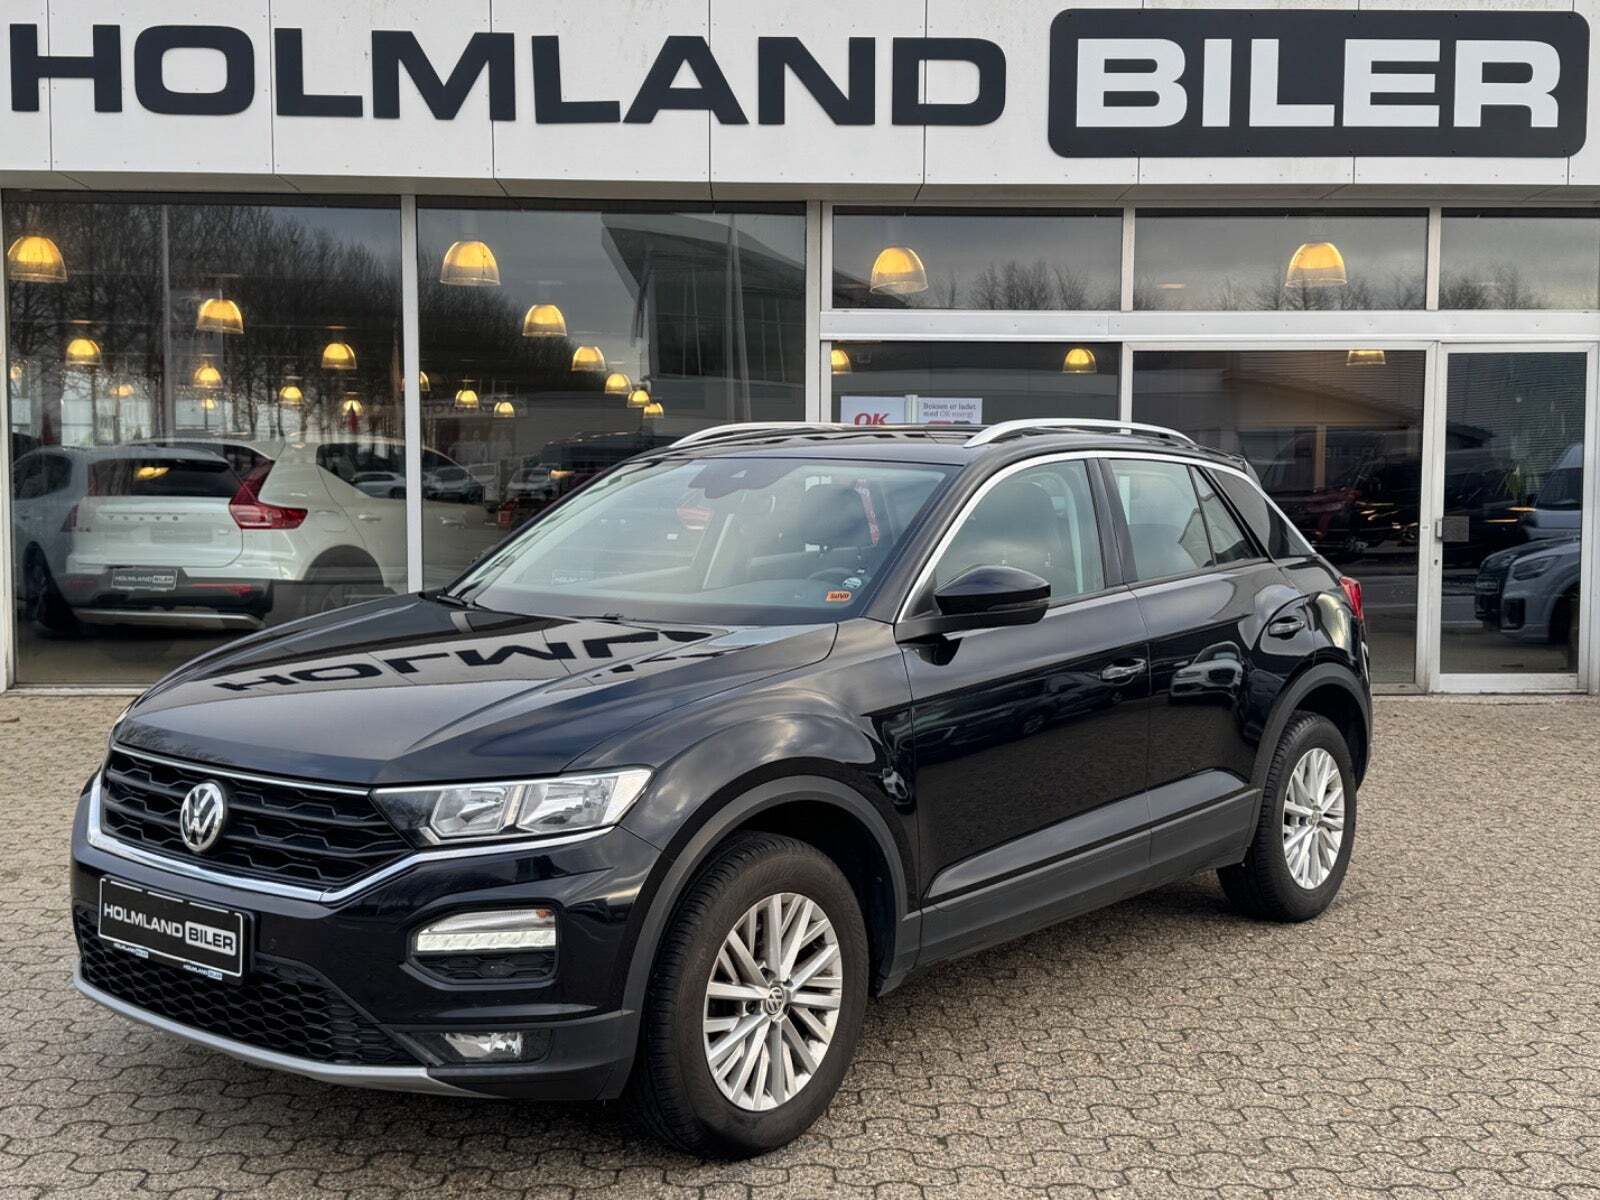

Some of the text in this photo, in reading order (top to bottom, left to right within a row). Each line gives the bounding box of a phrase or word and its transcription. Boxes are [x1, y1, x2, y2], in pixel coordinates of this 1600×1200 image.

[9, 23, 1561, 129] HOLMLAND BILER
[103, 902, 234, 951] HOLMLAND BILER
